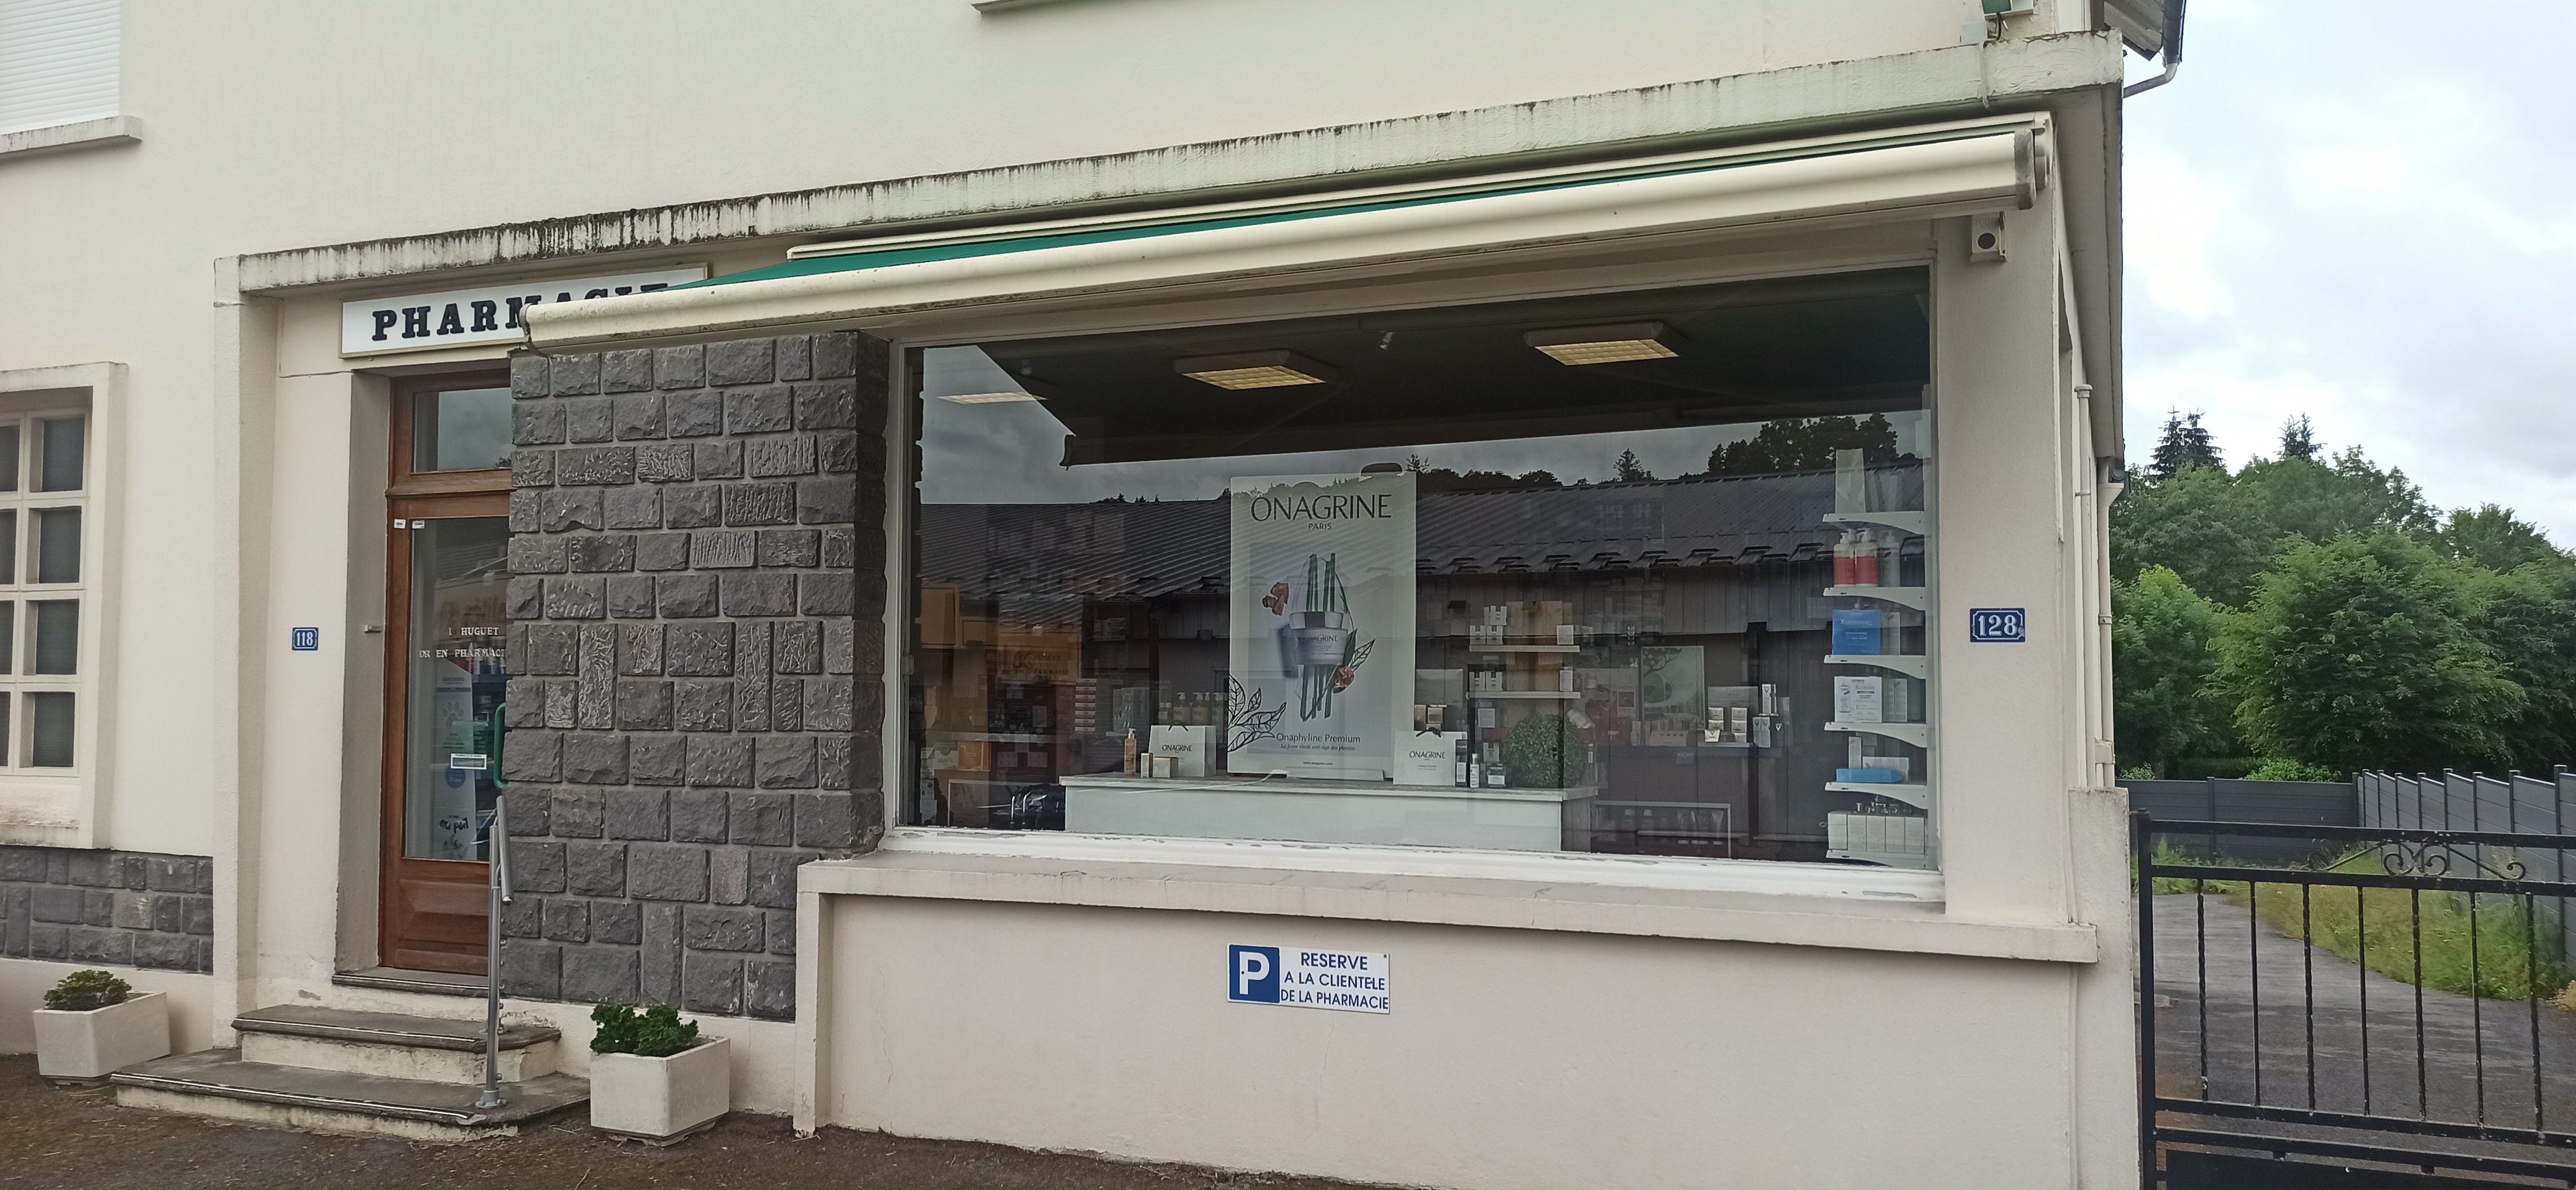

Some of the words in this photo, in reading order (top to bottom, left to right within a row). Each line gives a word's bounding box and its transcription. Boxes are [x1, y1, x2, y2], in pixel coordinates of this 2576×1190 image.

[372, 282, 667, 341] PHARM
[1251, 494, 1392, 521] ONAGRINE
[461, 627, 499, 636] HUGUET
[1978, 614, 2017, 636] 128
[296, 631, 313, 646] 118
[419, 650, 431, 658] DR
[436, 649, 448, 658] EN
[455, 648, 507, 657] PHARMACI
[1276, 733, 1322, 743] Onaphyline
[1325, 734, 1360, 743] Premium
[1409, 750, 1446, 759] ONAGRINE
[1301, 952, 1368, 970] RESERVE
[1239, 950, 1270, 995] P
[1284, 971, 1294, 983] A
[1299, 972, 1314, 985] LA
[1319, 973, 1385, 991] CLIENTELE
[1281, 989, 1295, 1002] DE
[1299, 991, 1313, 1003] LA
[1317, 992, 1388, 1009] PHARMACIE
